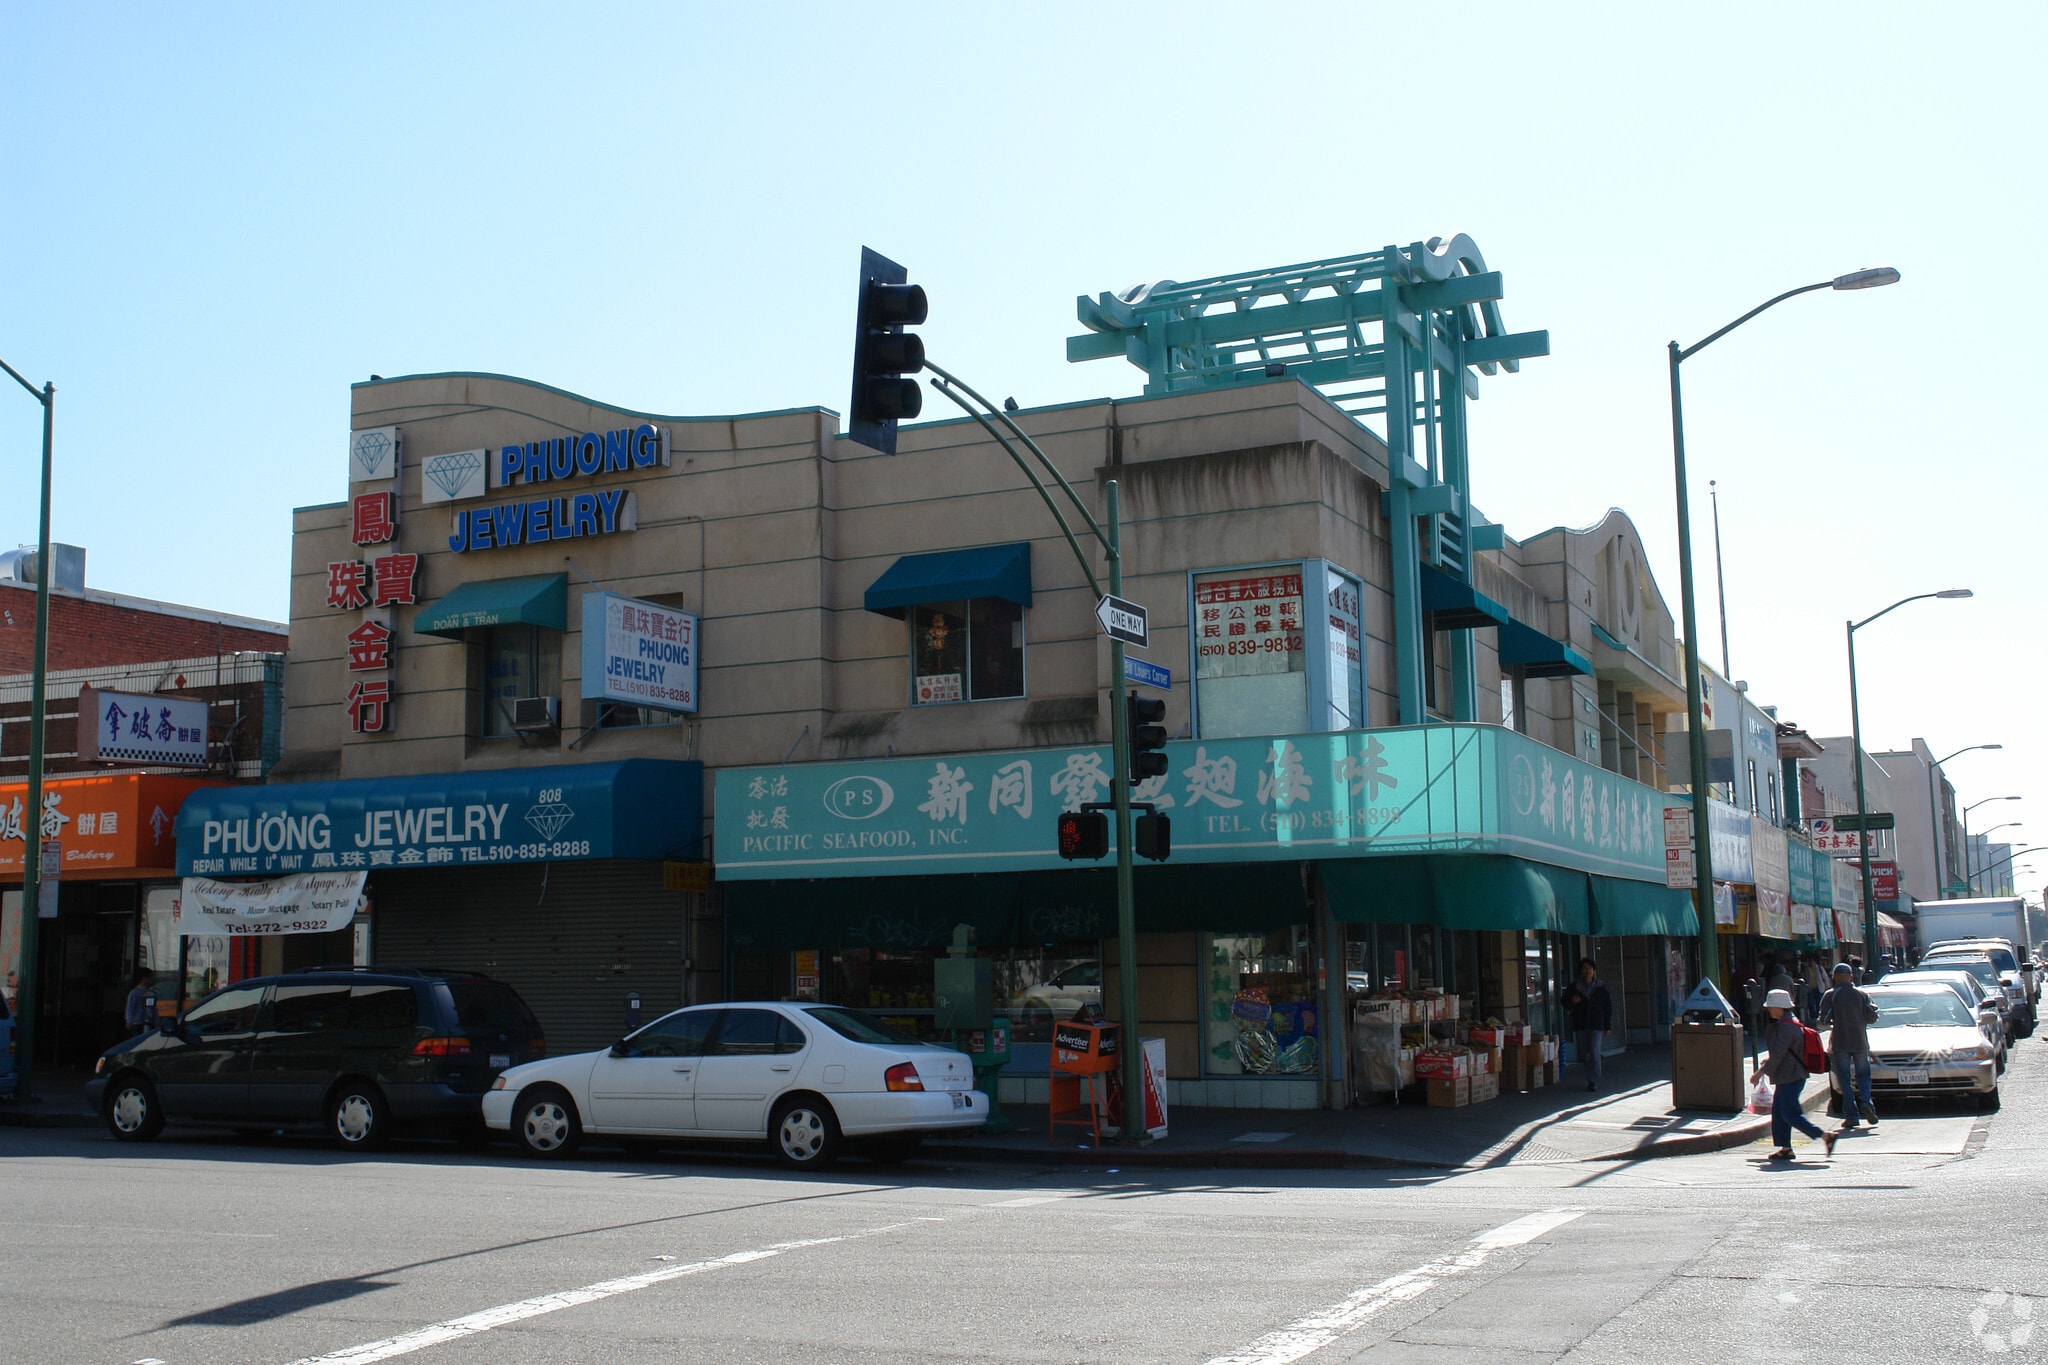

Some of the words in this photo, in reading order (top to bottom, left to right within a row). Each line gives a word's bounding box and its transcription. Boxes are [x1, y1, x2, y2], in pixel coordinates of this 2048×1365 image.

[501, 424, 658, 486] PHUONG
[448, 489, 623, 553] JEWELRY
[433, 618, 459, 630] DOAN
[462, 617, 469, 627] &
[474, 614, 499, 626] TRAN
[623, 606, 691, 644] 鳳珠寶金行
[1111, 609, 1126, 626] ONE
[1128, 613, 1143, 632] WAY
[639, 638, 689, 666] PHUONG
[1200, 644, 1224, 656] (510)
[1228, 636, 1302, 656] 839-9832
[607, 656, 665, 684] JEWELRY
[539, 788, 562, 804] 808
[354, 804, 508, 848] JEWELRY
[1204, 815, 1250, 833] TEL.
[1260, 812, 1305, 833] (510)
[1311, 807, 1402, 828] 834-8898
[743, 833, 812, 853] PACIFIC
[823, 830, 917, 850] SEAFOOD,
[929, 829, 968, 847] INC.
[65, 849, 115, 861] Bakery
[193, 858, 224, 873] REPAIR
[230, 856, 257, 871] WHILE
[280, 855, 303, 868] WAIT
[1667, 850, 1678, 859] NO
[191, 880, 234, 900] Mekong
[202, 905, 215, 915] Real
[216, 905, 236, 915] Estate
[247, 906, 266, 915] Home
[268, 903, 300, 914] Mortgage
[311, 900, 333, 911] Notary
[335, 899, 350, 908] Publi
[1056, 1033, 1089, 1046] Advertiser
